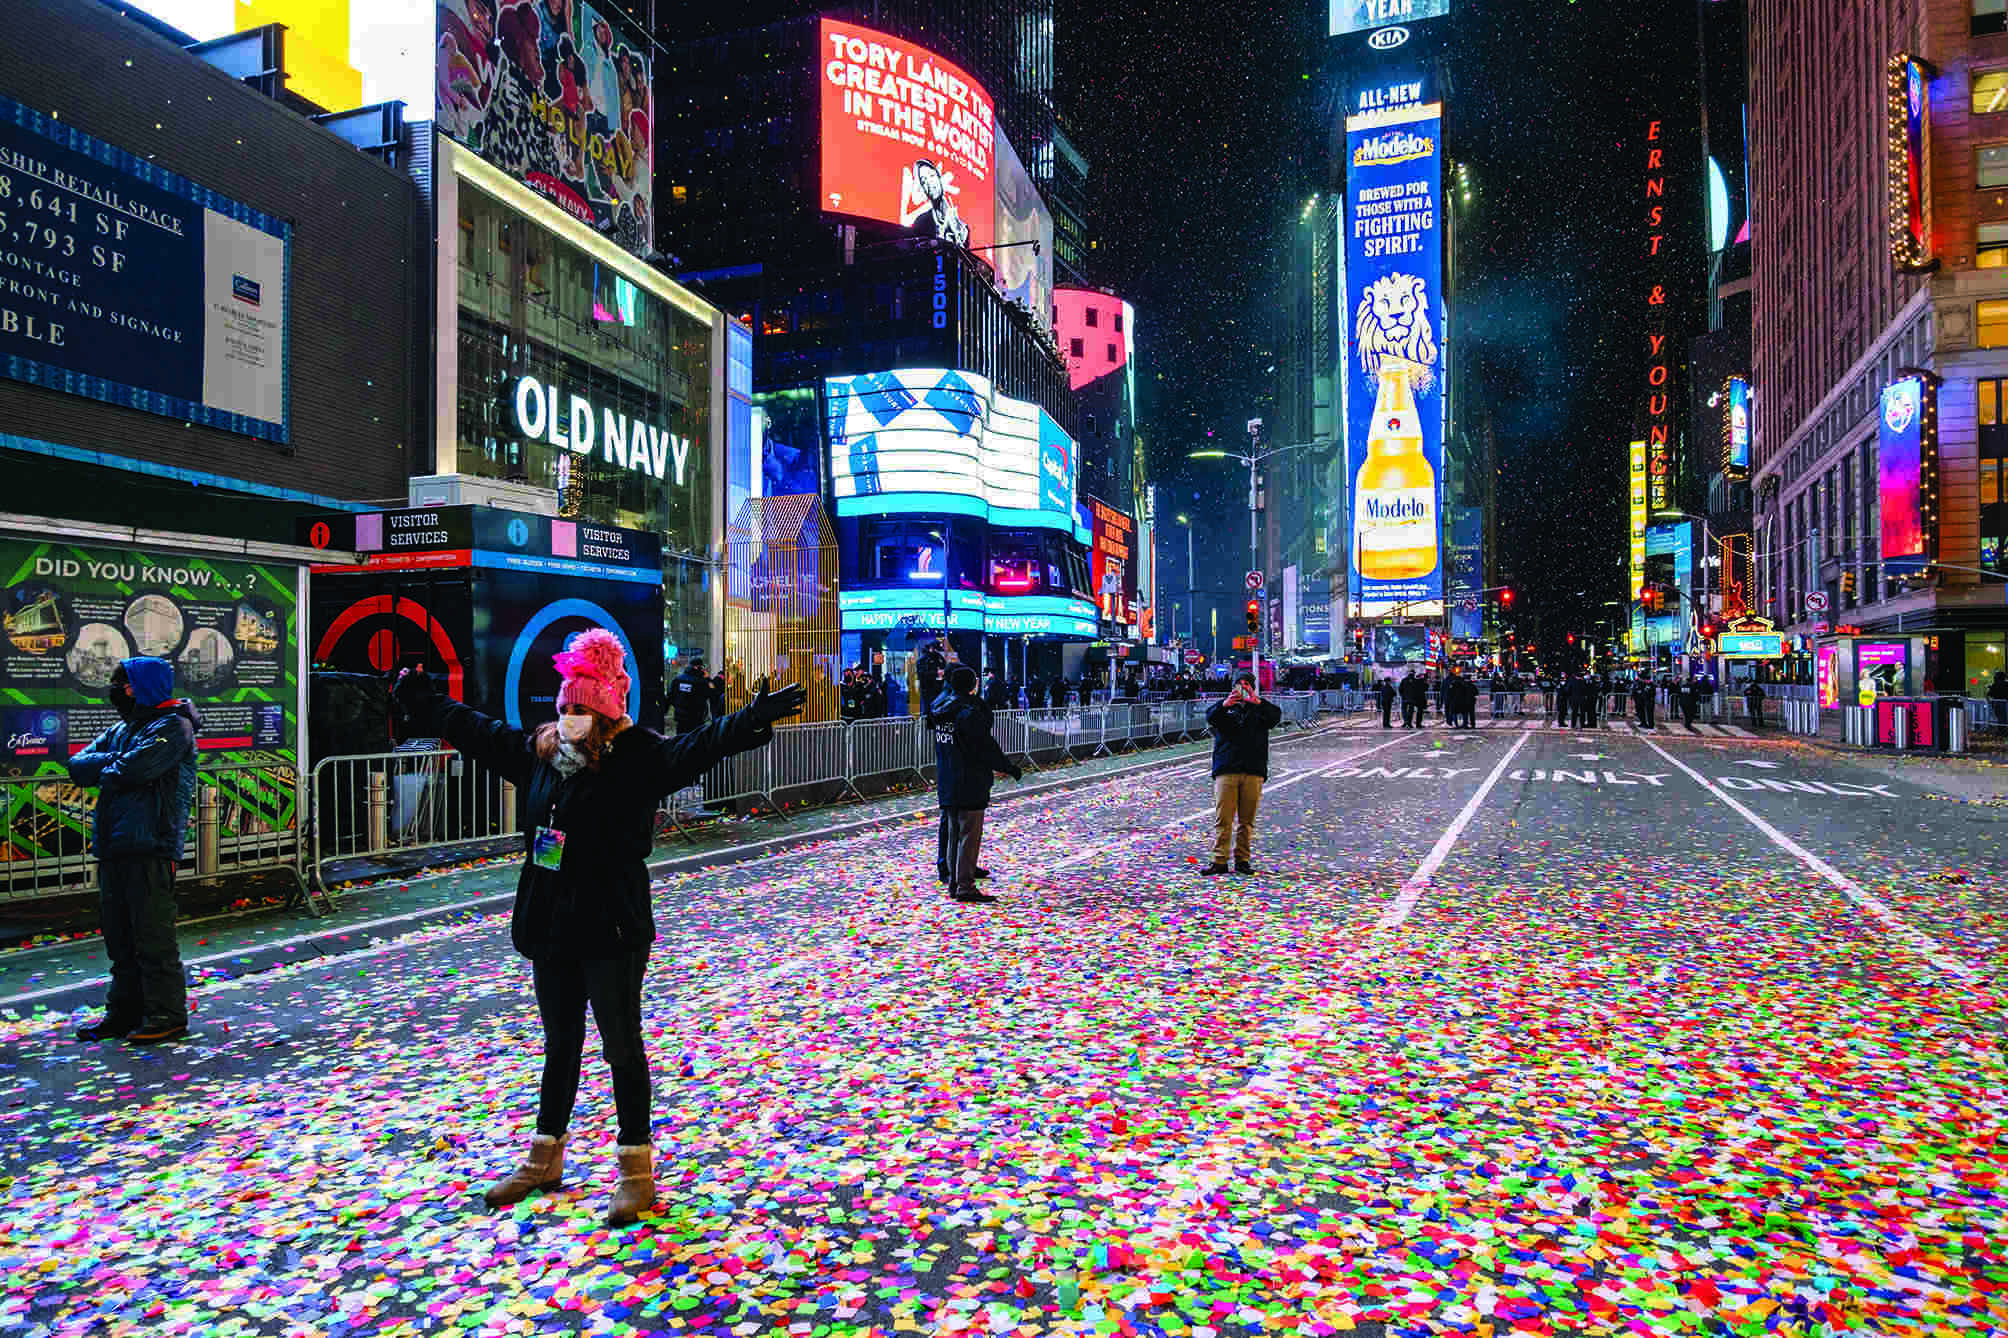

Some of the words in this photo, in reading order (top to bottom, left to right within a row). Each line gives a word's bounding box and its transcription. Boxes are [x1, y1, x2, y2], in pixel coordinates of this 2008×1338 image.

[1375, 31, 1402, 45] KIA
[829, 33, 903, 72] TORY
[906, 56, 969, 107] LANEZ
[971, 90, 993, 130] THE
[826, 61, 948, 118] GREATEST
[951, 104, 994, 153] ARTIST
[1360, 82, 1422, 109] ALL-NEW
[844, 88, 872, 118] IN
[878, 98, 927, 134] THE
[1363, 133, 1423, 160] Modelo
[1360, 184, 1404, 202] BREWED
[1406, 181, 1428, 197] FOR
[1646, 119, 1664, 257] ERNST
[0, 175, 77, 224] 8,641
[95, 213, 129, 241] SF
[54, 168, 123, 209] RETAIL
[128, 200, 183, 234] SPACE
[1356, 201, 1392, 217] THOSE
[1393, 197, 1423, 213] WITH
[1424, 195, 1433, 210] A
[1354, 211, 1433, 238] FIGHTING
[1364, 233, 1424, 257] SPIRIT.
[92, 245, 127, 273] SF
[933, 255, 947, 329] 1500
[1648, 284, 1665, 305] &
[1, 308, 65, 347] BLE
[67, 299, 103, 319] AND
[110, 311, 183, 344] SIGNAGE
[1648, 334, 1668, 476] YOUNG
[515, 375, 596, 455] OLD
[603, 407, 690, 487] NAVY
[1367, 496, 1424, 518] Modelo
[390, 513, 439, 529] VISITOR
[390, 530, 448, 546] SERVICES
[583, 527, 623, 545] VISITOR
[583, 544, 630, 561] SERVICES
[35, 557, 81, 578] DID
[87, 560, 136, 582] YOU
[928, 613, 960, 626] YEAR
[1023, 616, 1049, 630] YEAR
[1319, 767, 1481, 779] ONLY
[1508, 768, 1673, 786] ONLY
[1715, 776, 1901, 798] ONLY
